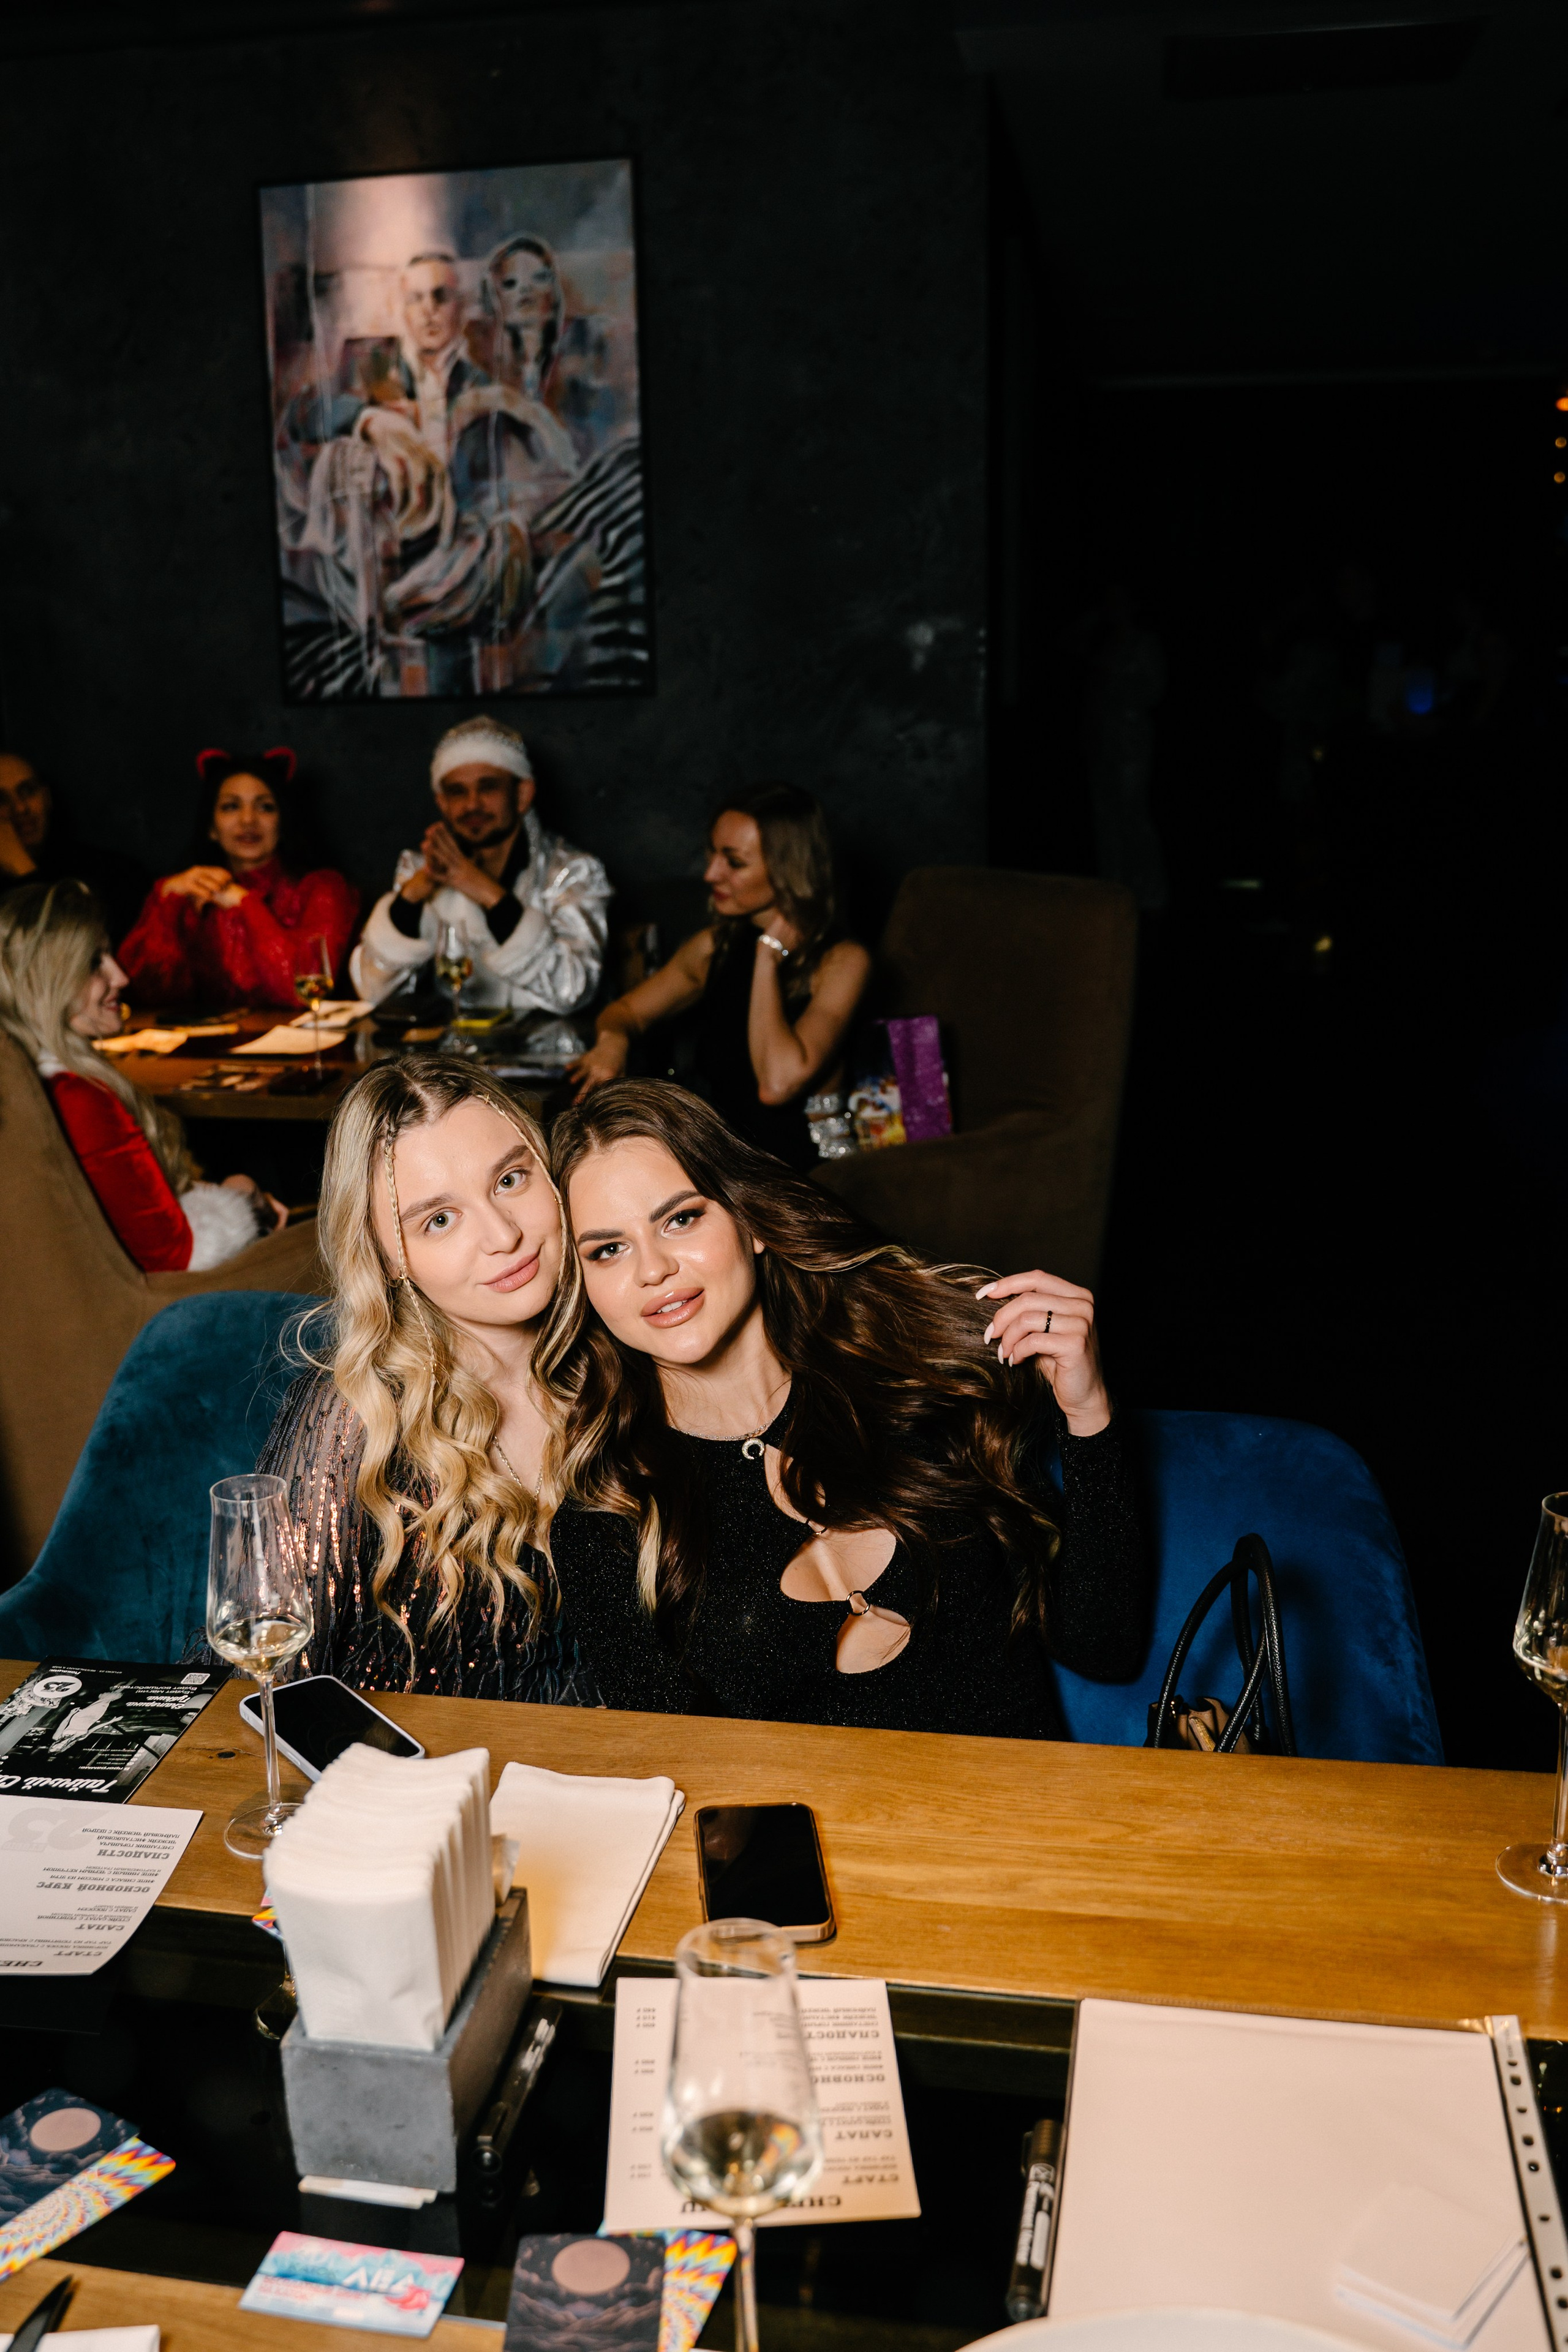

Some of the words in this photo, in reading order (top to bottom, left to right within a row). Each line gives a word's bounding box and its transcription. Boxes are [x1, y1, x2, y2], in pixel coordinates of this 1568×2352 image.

[40, 1682, 76, 1692] 23
[21, 1776, 118, 1793] Тайный
[97, 1849, 170, 1860] СЛАДОСТИ
[36, 1881, 74, 1890] КУРС
[77, 1883, 151, 1893] ОСНОВНОЙ
[806, 2030, 880, 2040] СЛАДОСТ
[811, 2074, 884, 2084] ОСНОВНО
[835, 2130, 892, 2139] САЛАТ
[843, 2174, 899, 2184] СТАРТ
